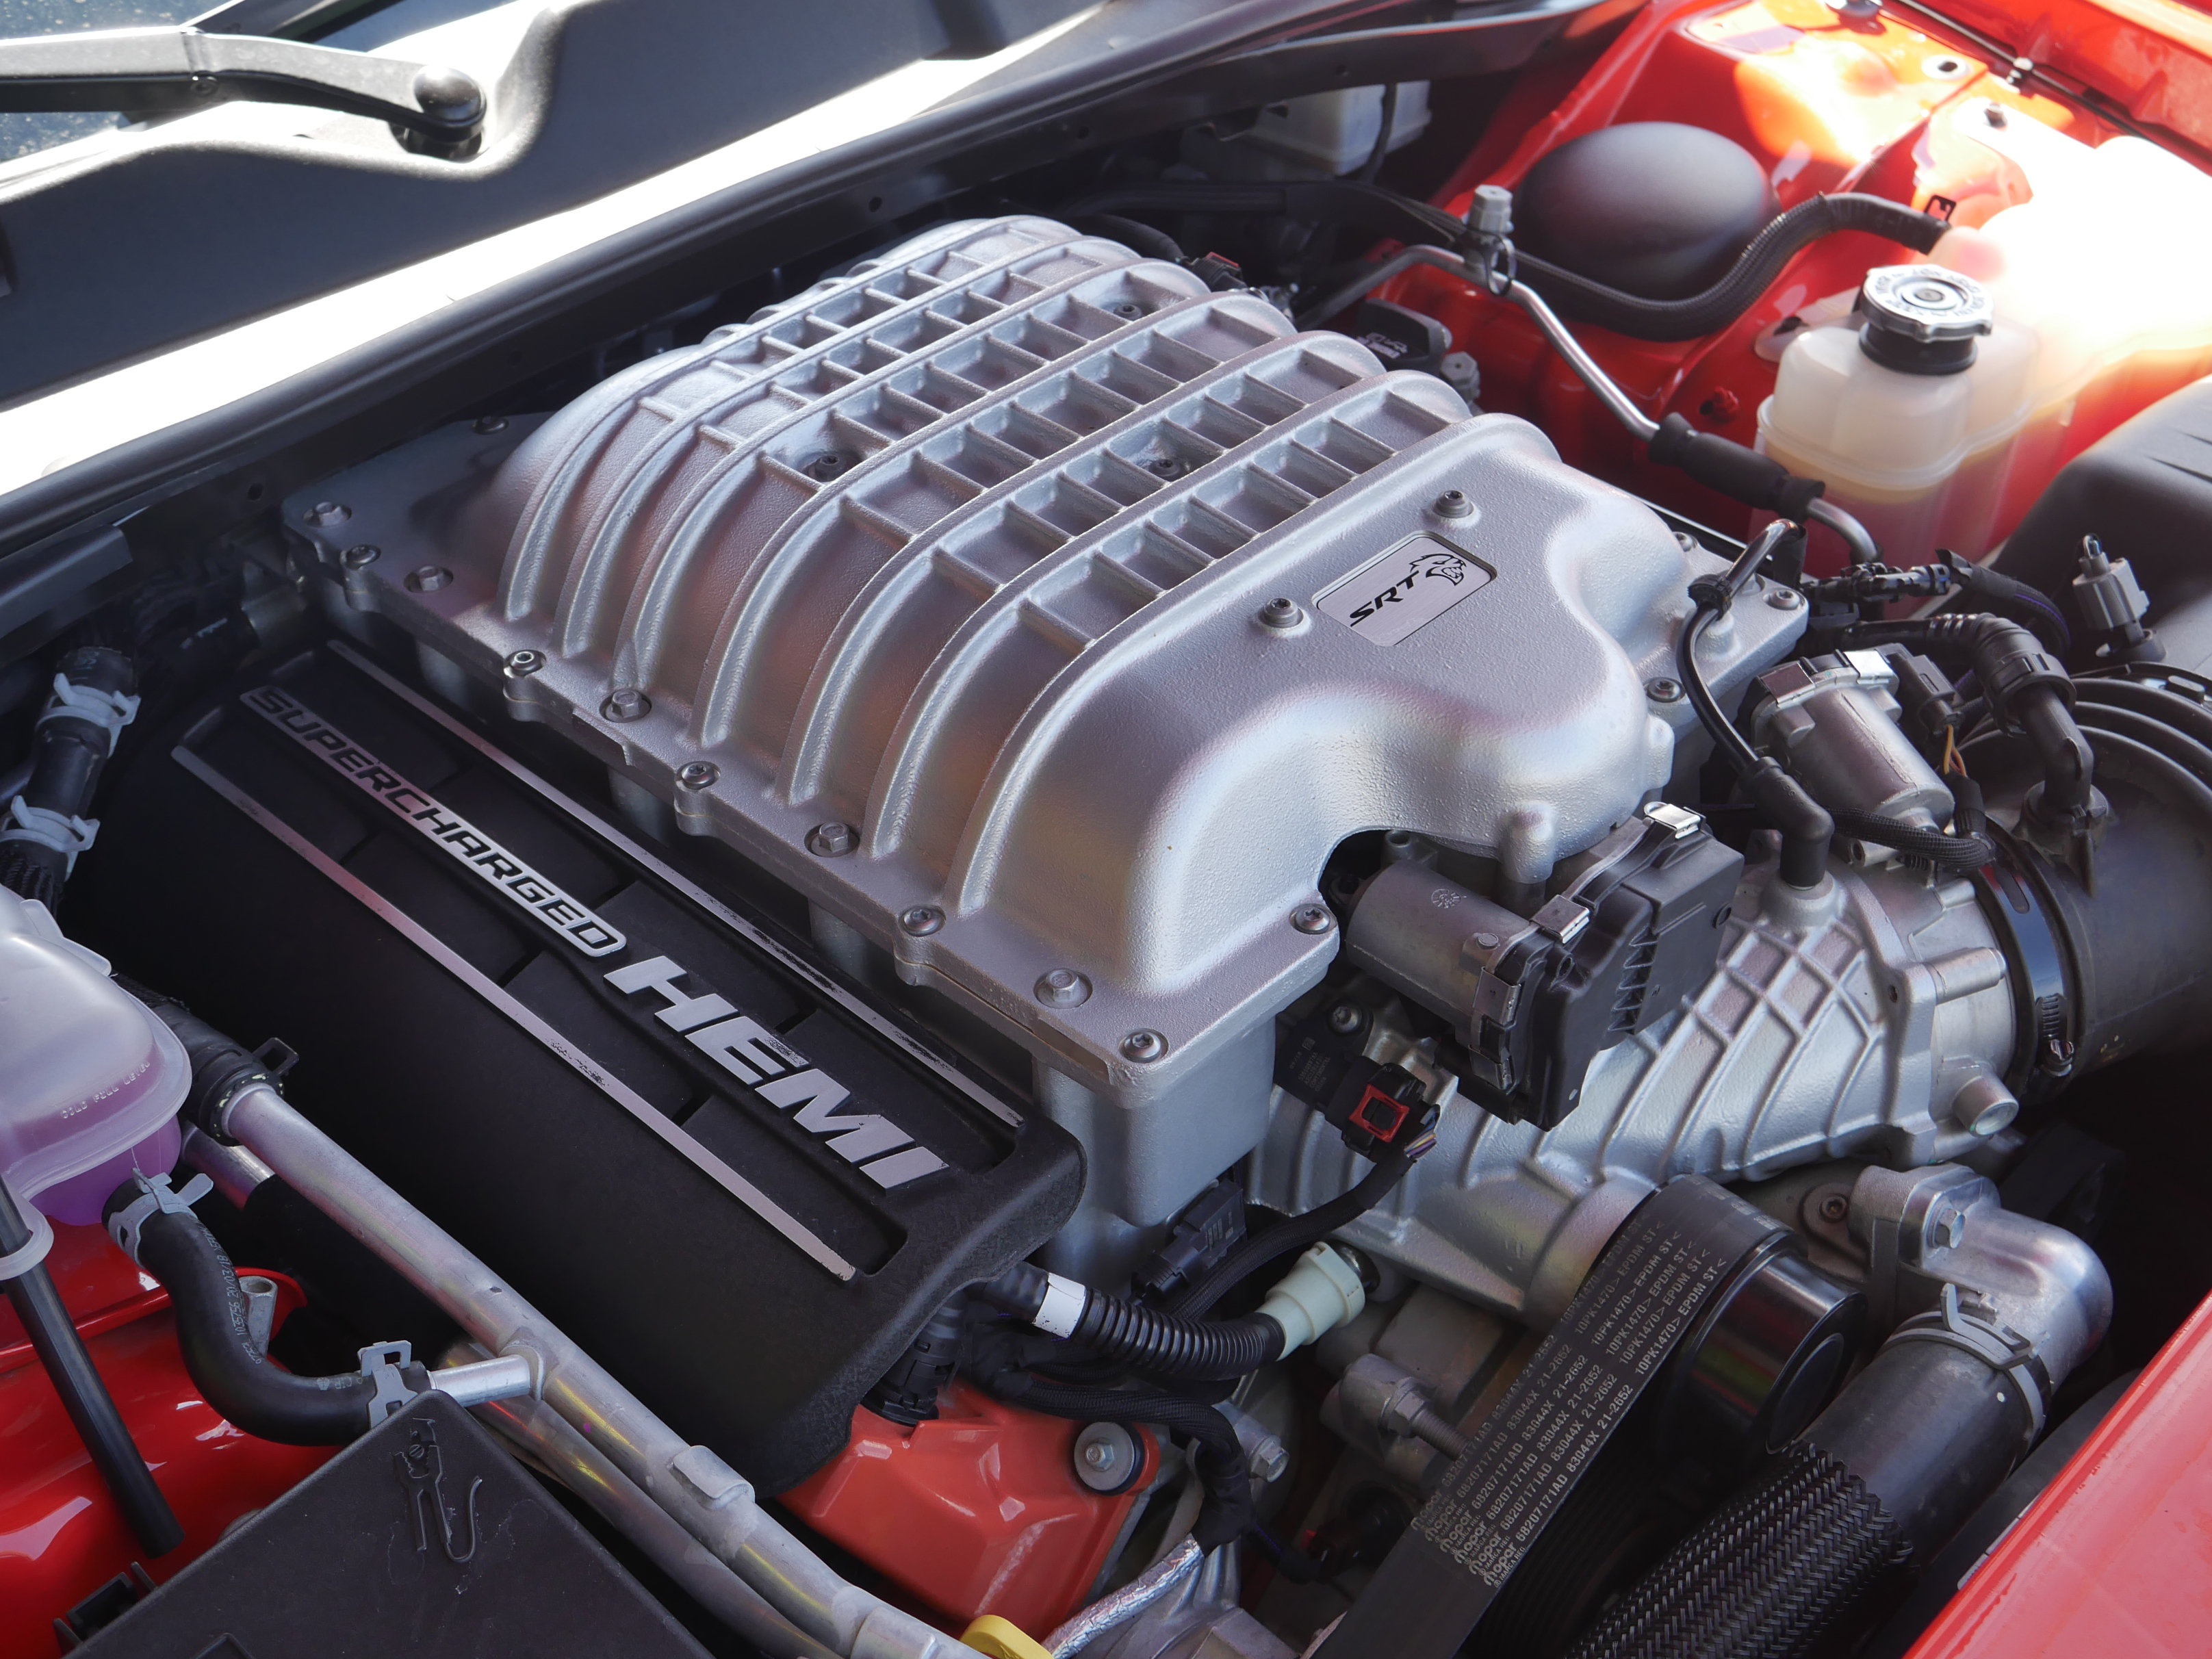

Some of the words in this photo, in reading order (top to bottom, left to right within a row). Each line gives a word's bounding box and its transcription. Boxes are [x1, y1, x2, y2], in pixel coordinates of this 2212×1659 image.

[1350, 570, 1419, 628] SRT
[248, 688, 619, 950] SUPERCHARGED
[603, 955, 949, 1189] HEMI
[1456, 1432, 1508, 1497] 68207171AD
[1506, 1389, 1539, 1430] 83044X
[1537, 1343, 1572, 1387] 21-2652
[1617, 1244, 1645, 1276] EPDM
[1471, 1443, 1523, 1508] 68207171AD
[1521, 1400, 1554, 1440] 83044X
[1552, 1354, 1588, 1398] 21-2652
[1634, 1255, 1662, 1286] EPDM
[1483, 1542, 1516, 1585] mopar
[1515, 1474, 1567, 1541] 68207171AD
[1566, 1430, 1599, 1471] 83044X
[1597, 1384, 1633, 1429] 21-2652
[1677, 1282, 1706, 1315] EPDM
[1486, 1452, 1538, 1519] 68207171AD
[1536, 1410, 1569, 1451] 83044X
[1567, 1364, 1603, 1409] 21-2652
[1649, 1263, 1676, 1296] EPDM
[1500, 1463, 1552, 1530] 68207171AD
[1551, 1419, 1584, 1461] 83044X
[1581, 1374, 1617, 1418] 21-2652
[1662, 1272, 1690, 1305] EPDM
